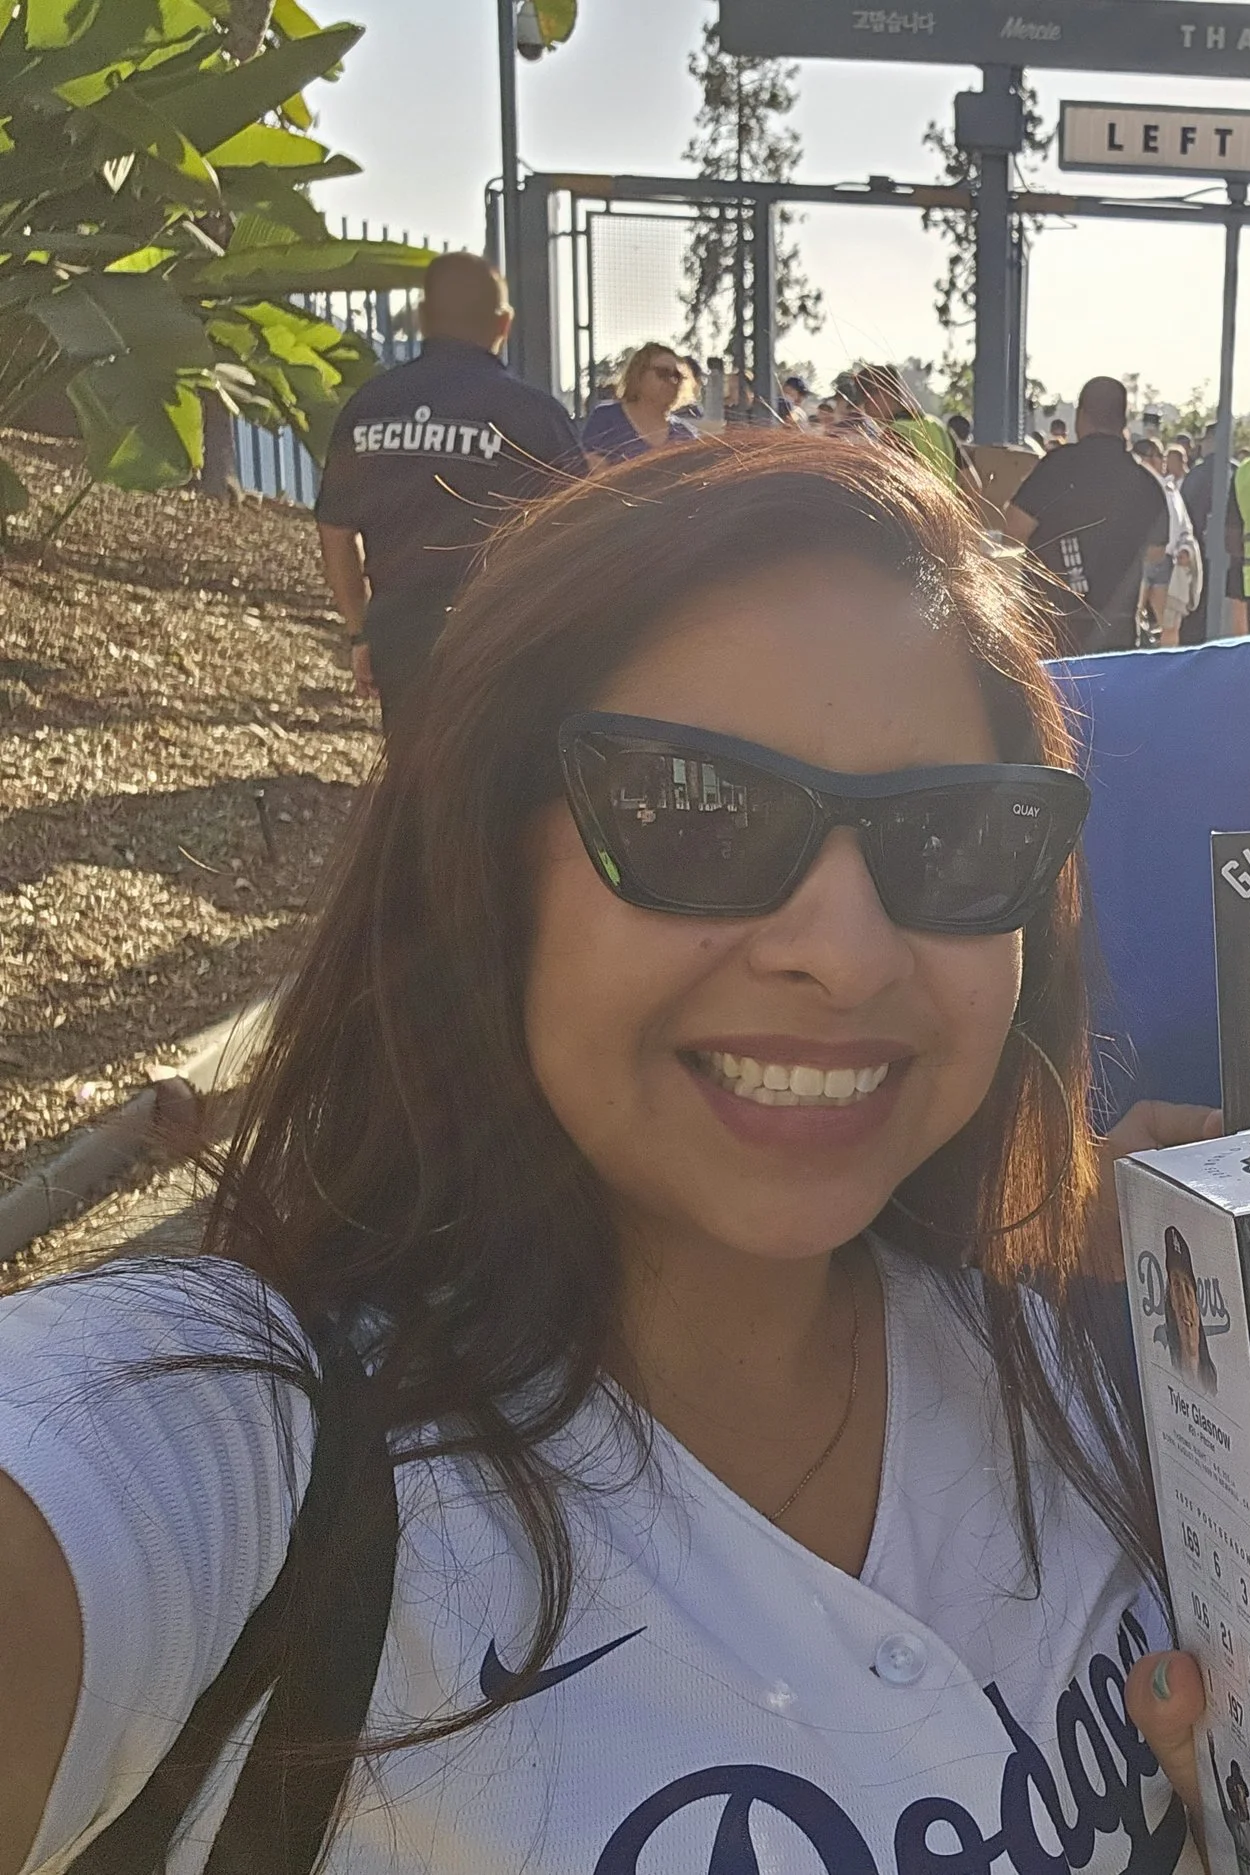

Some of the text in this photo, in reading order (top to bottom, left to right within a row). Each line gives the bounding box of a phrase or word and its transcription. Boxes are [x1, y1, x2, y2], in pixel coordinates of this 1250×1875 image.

[852, 9, 936, 35] 고맙습니다
[1107, 122, 1232, 157] LEFT
[353, 422, 501, 459] SECURITY
[1012, 803, 1040, 818] QUAY
[1168, 1385, 1189, 1417] Tyler
[1192, 1403, 1231, 1451] Glasnow
[1197, 1507, 1250, 1566] POSTSEASON
[1213, 1550, 1221, 1578] 6
[1240, 1577, 1248, 1606] 3
